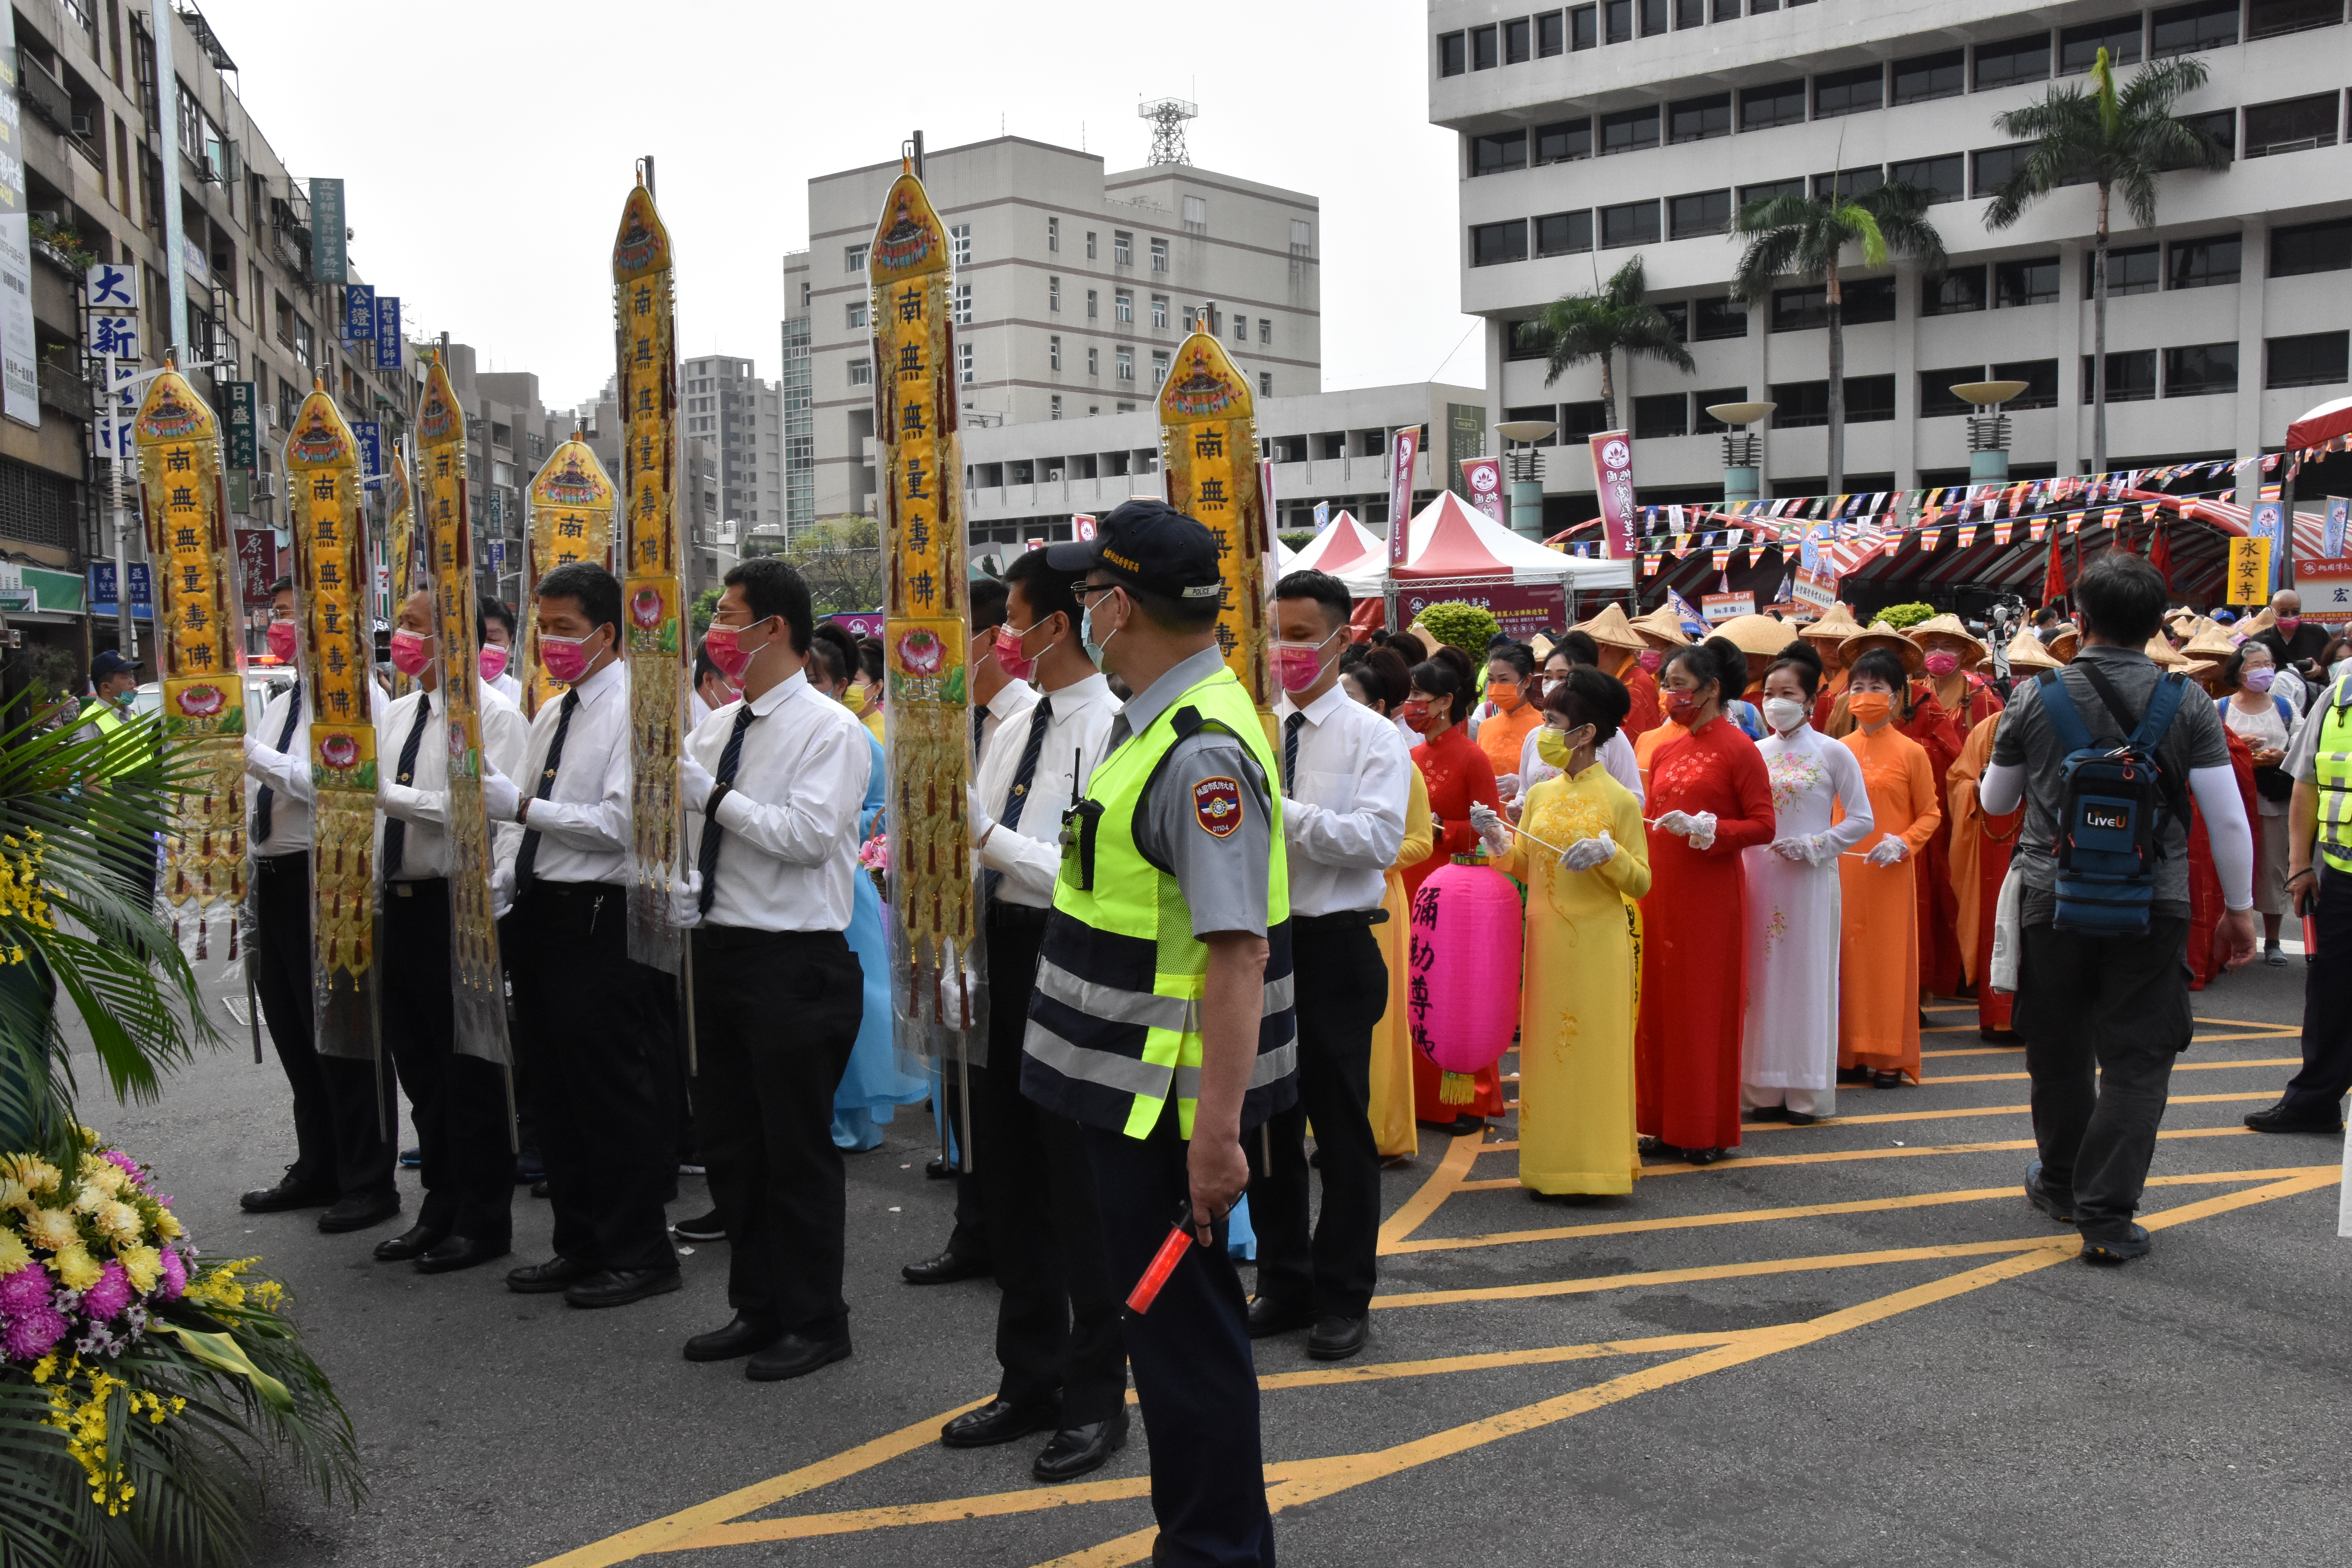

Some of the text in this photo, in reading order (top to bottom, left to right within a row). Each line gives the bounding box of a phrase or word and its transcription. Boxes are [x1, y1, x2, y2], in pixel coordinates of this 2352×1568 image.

[351, 287, 371, 327] 公證
[232, 386, 250, 424] 日盛
[240, 428, 251, 463] 地政士
[635, 284, 658, 568] 南無無量壽佛
[898, 286, 935, 610] 南無無量壽佛
[167, 447, 213, 671] 南無無量壽佛
[436, 451, 462, 697] 南無無量壽佛
[2236, 539, 2260, 601] 永安寺
[2318, 563, 2352, 573] 桃園佛教
[99, 582, 147, 591] 髮型作室
[314, 474, 351, 719] 南無無量壽佛
[2332, 588, 2350, 602] 宏
[1196, 781, 1234, 797] 桃園市民防大隊
[2087, 812, 2127, 828] LiveU
[1409, 887, 1441, 1066] 彌勒尊佛
